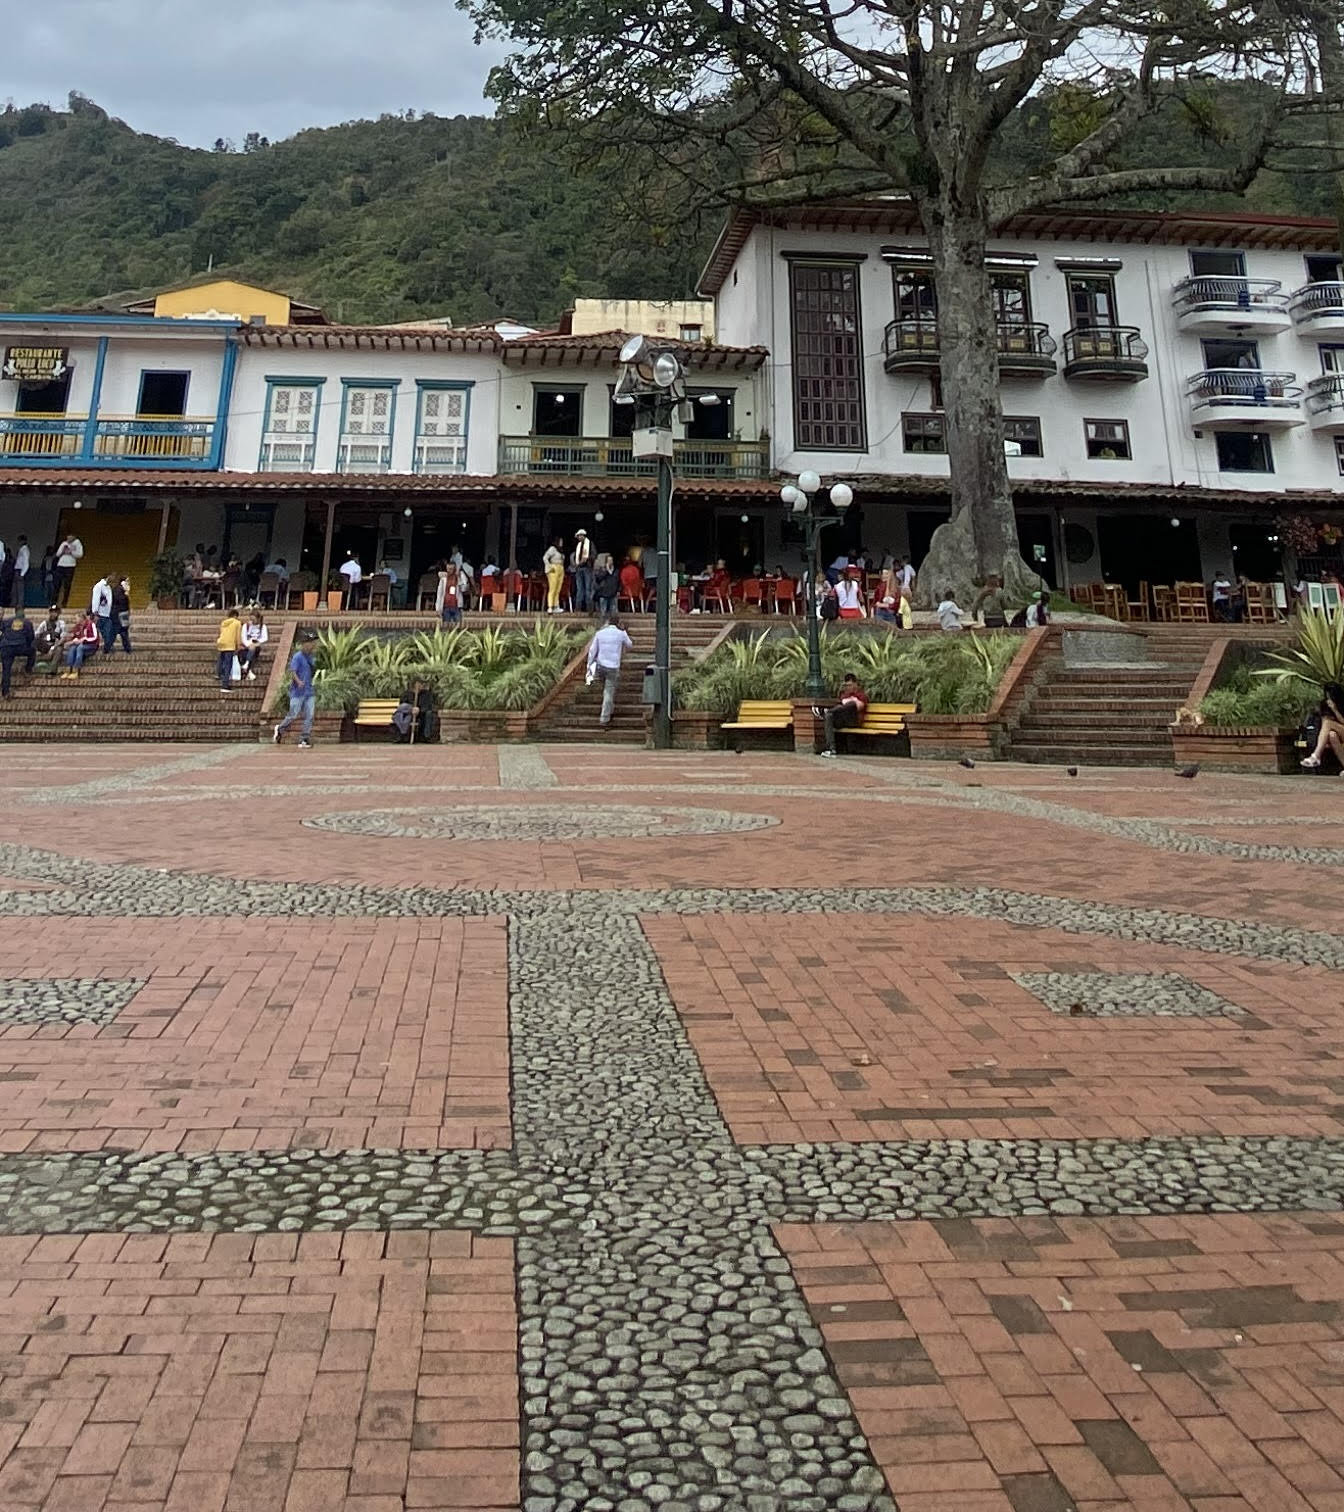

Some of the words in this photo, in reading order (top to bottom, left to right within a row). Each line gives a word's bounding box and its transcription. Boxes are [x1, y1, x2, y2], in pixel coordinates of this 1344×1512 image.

[9, 347, 63, 358] RESTAURANTE
[15, 358, 36, 368] POLLO
[37, 358, 55, 369] LOCO
